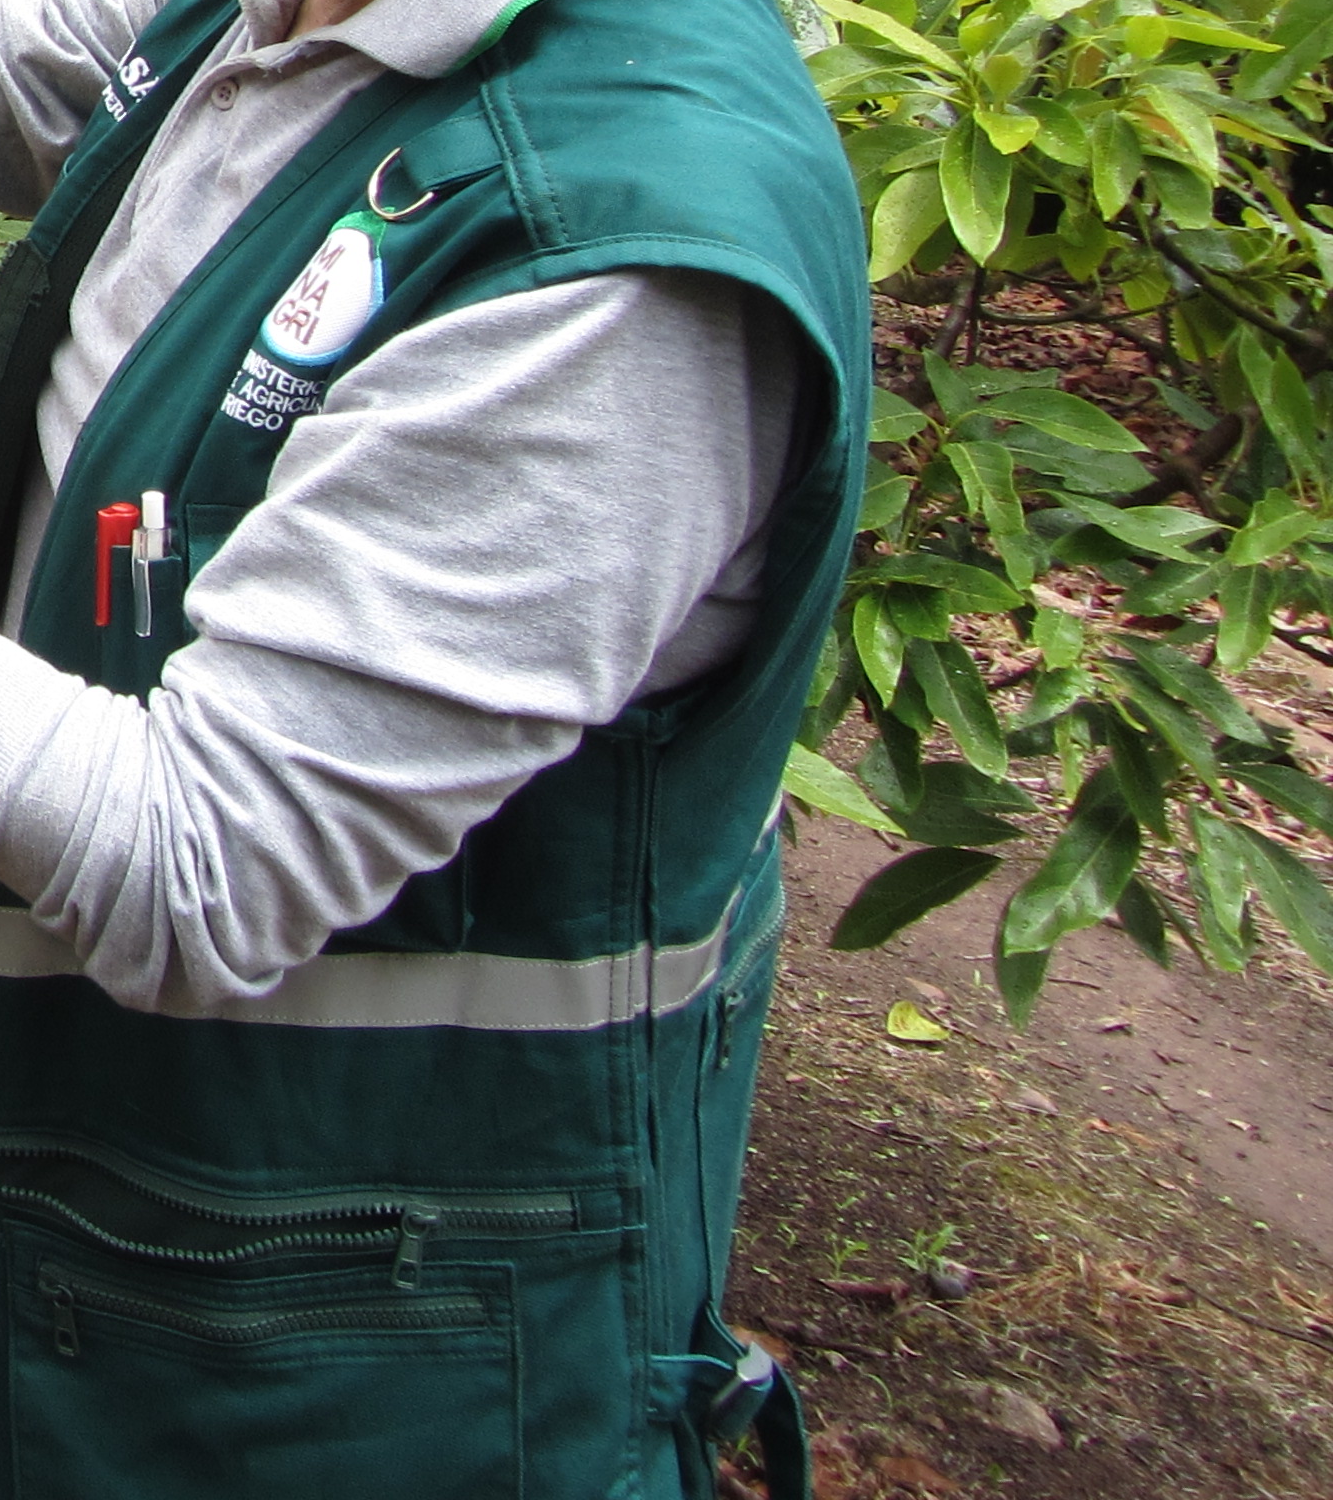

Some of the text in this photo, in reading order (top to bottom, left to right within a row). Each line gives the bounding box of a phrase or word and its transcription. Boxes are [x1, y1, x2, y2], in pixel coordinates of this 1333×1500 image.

[293, 267, 330, 312] NA
[273, 299, 320, 345] GRI
[220, 392, 284, 432] RIEGO
